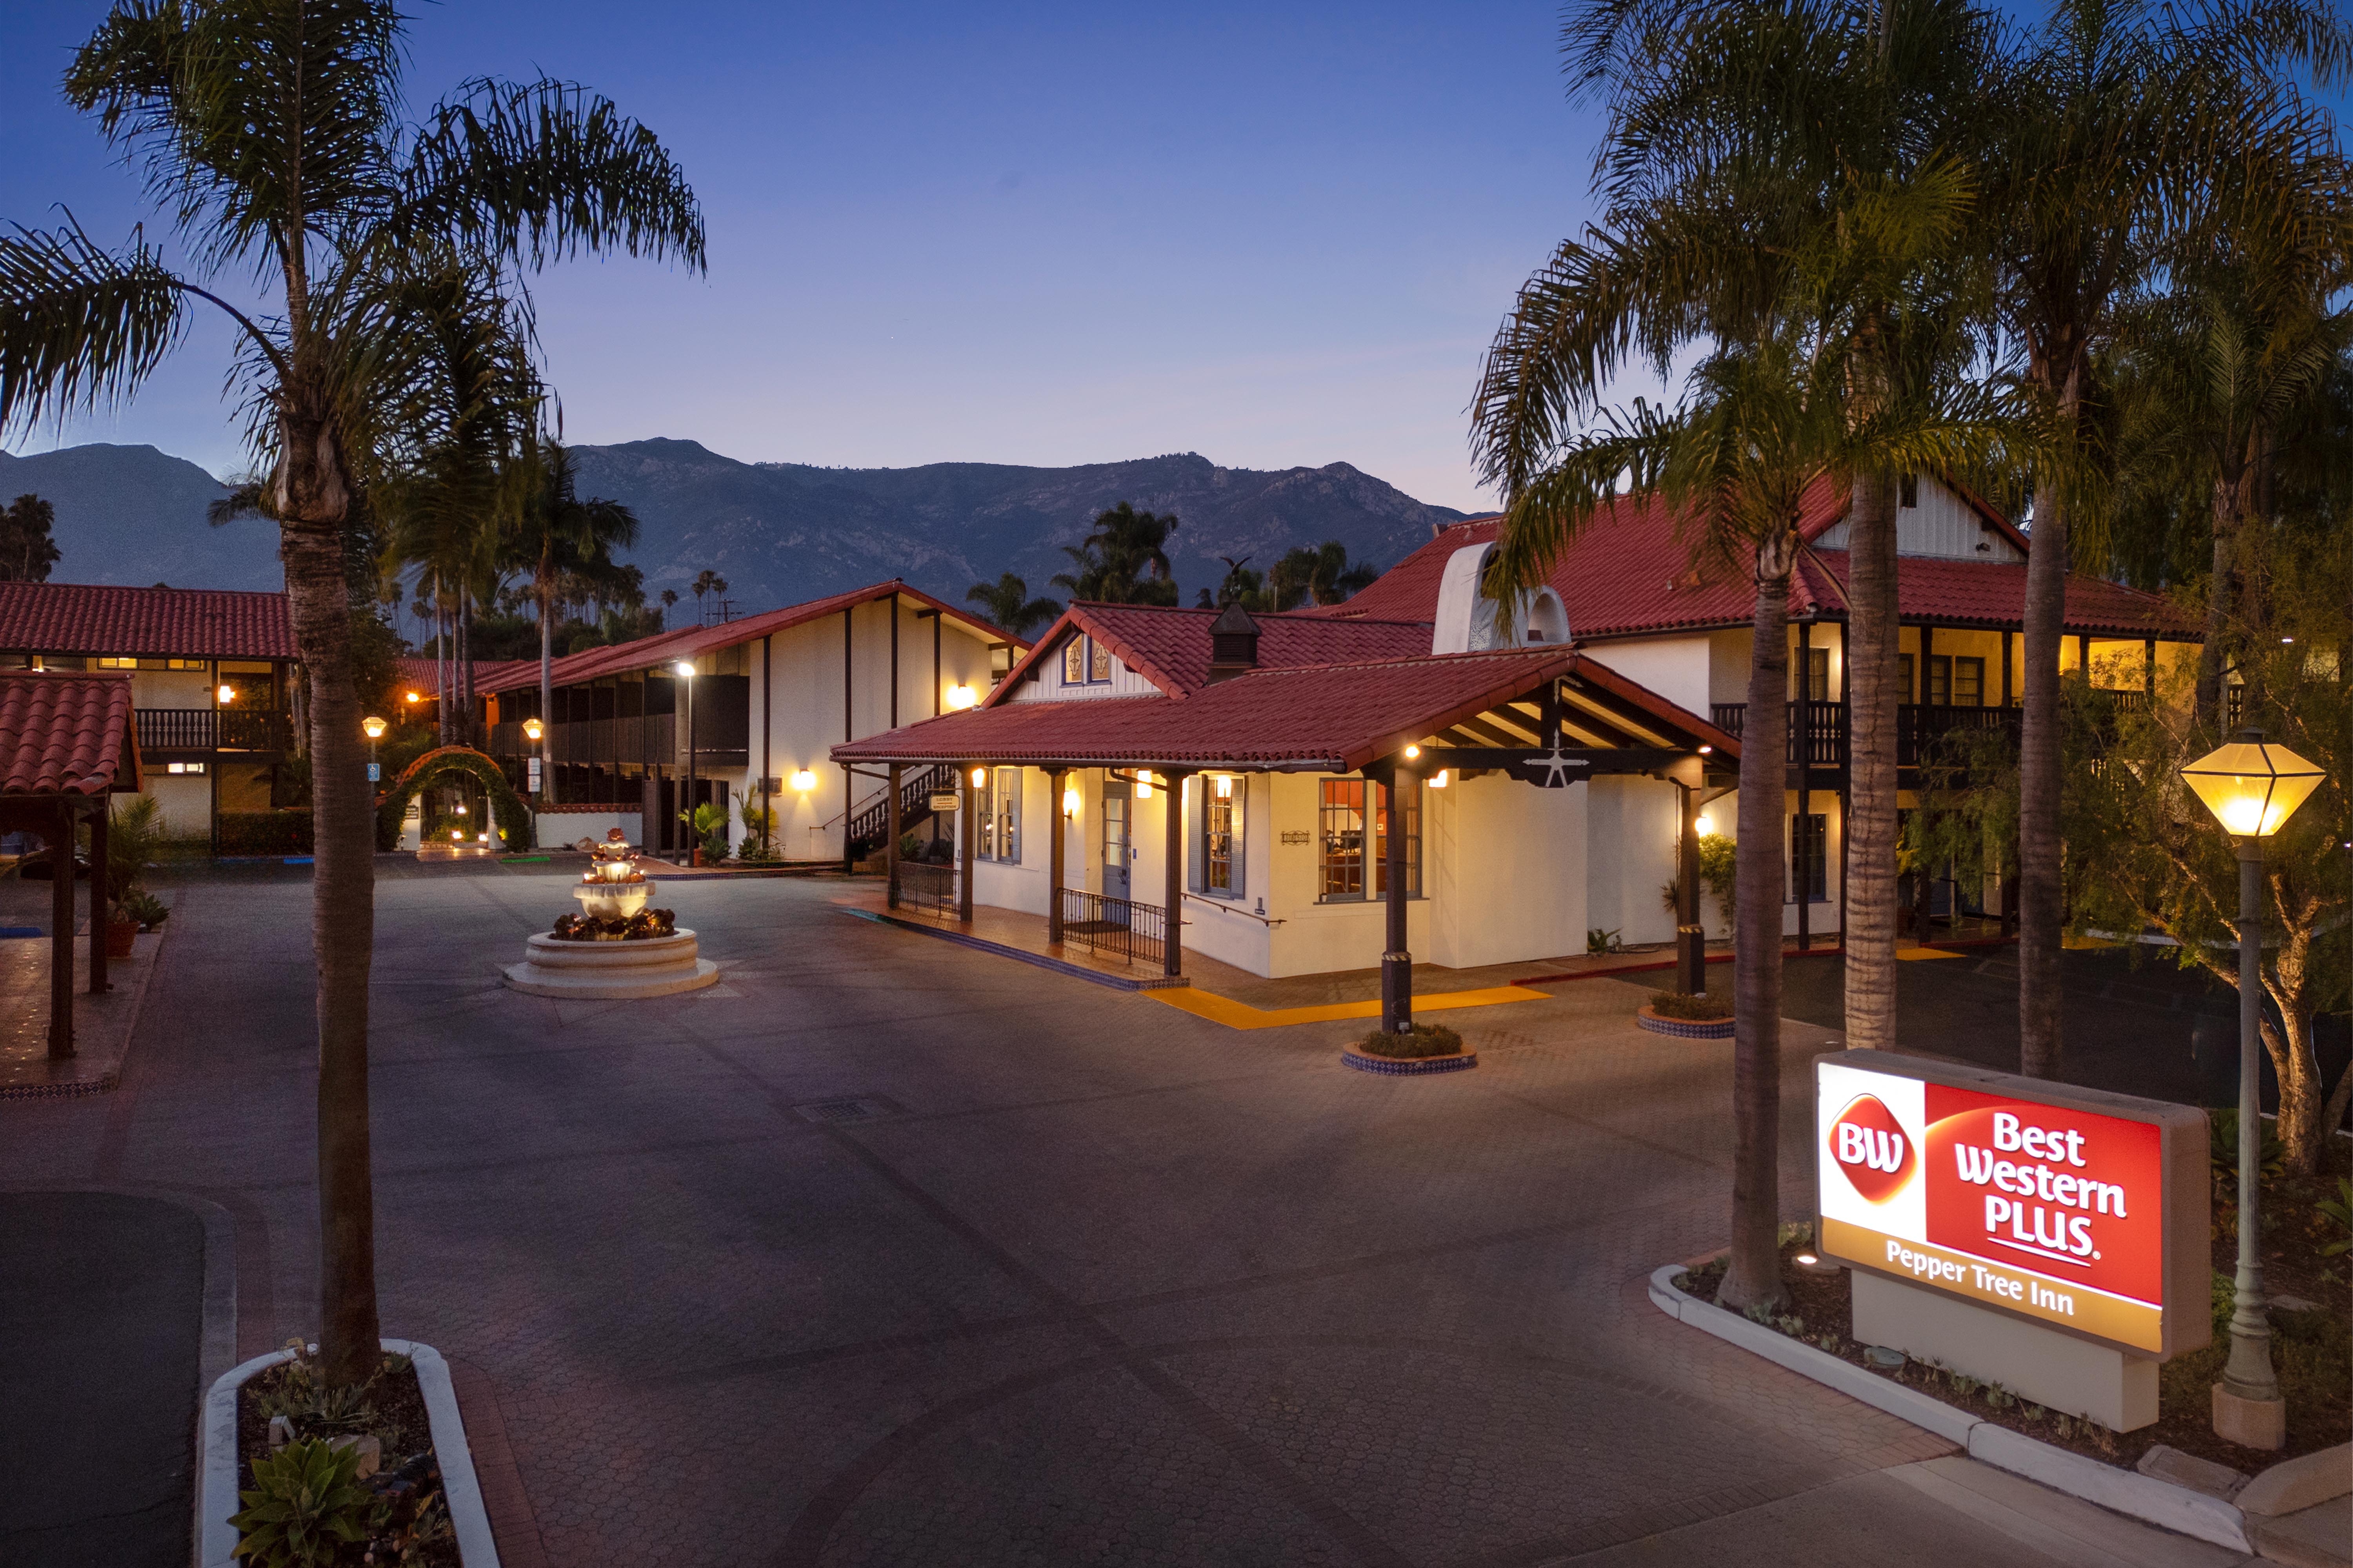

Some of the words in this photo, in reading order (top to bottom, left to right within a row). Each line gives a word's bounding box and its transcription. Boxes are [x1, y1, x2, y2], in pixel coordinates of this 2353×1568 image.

[1839, 1122, 1904, 1173] BW
[1994, 1113, 2086, 1167] Best
[1955, 1143, 2127, 1217] Western
[1986, 1195, 2093, 1256] PLUS
[1887, 1240, 1966, 1282] Pepper
[1971, 1264, 2023, 1300] Tree
[2031, 1281, 2074, 1315] Inn
